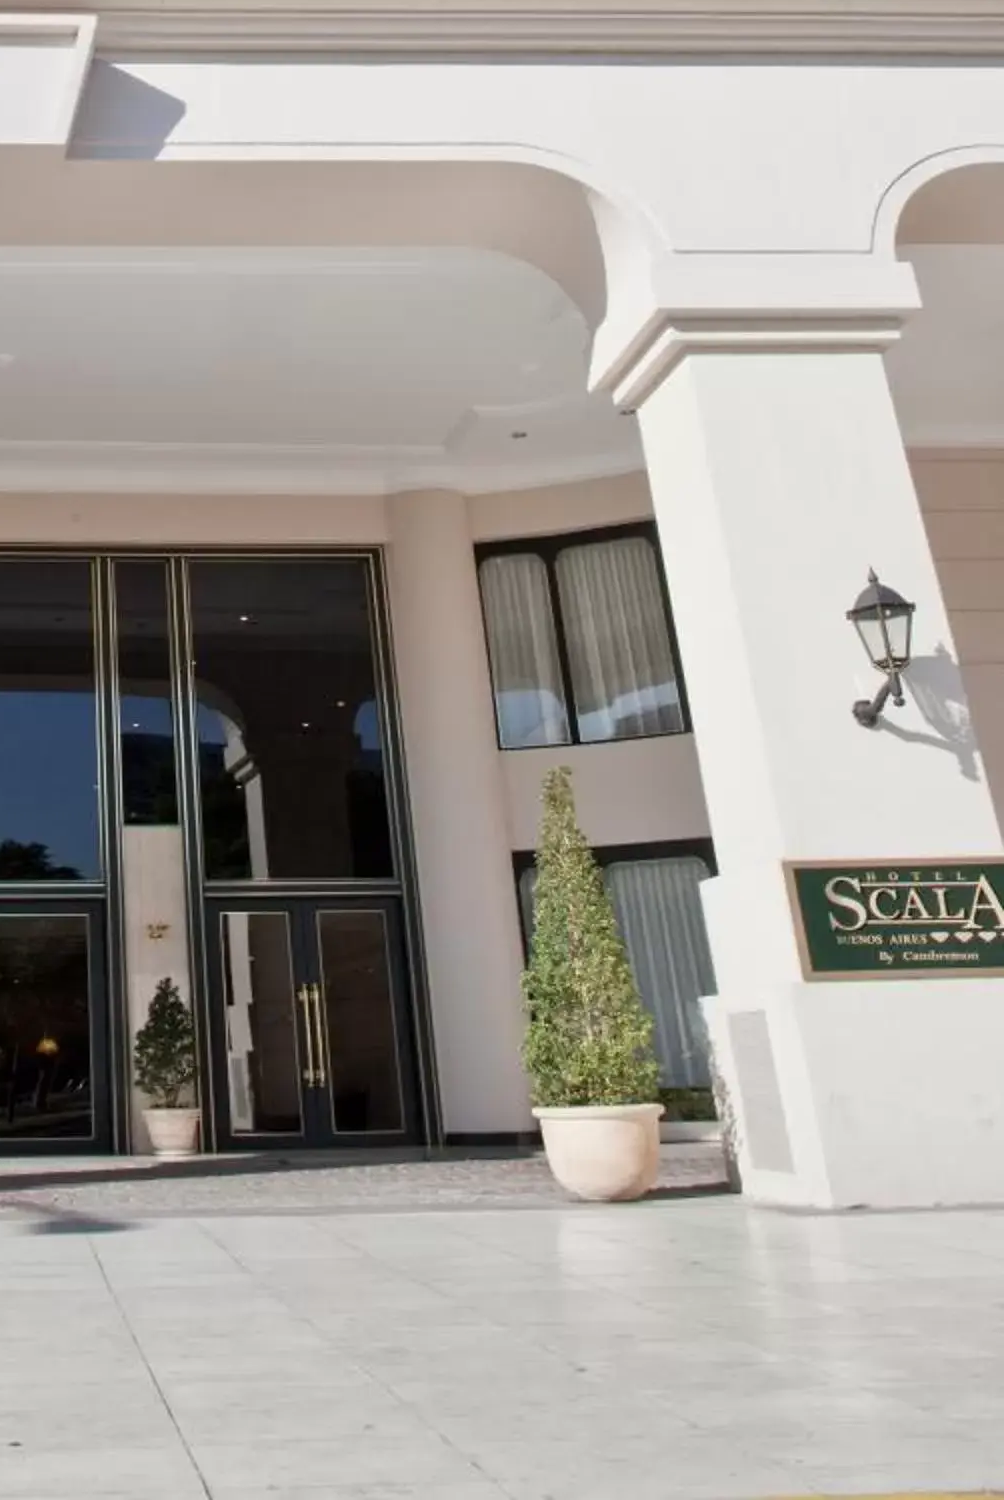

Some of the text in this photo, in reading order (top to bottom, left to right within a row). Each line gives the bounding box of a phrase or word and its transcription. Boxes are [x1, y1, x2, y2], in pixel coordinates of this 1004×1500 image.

[865, 871, 967, 881] HOTEL
[824, 873, 1004, 932] SCALA
[836, 933, 928, 946] BUENOS AIRES
[879, 951, 894, 964] By
